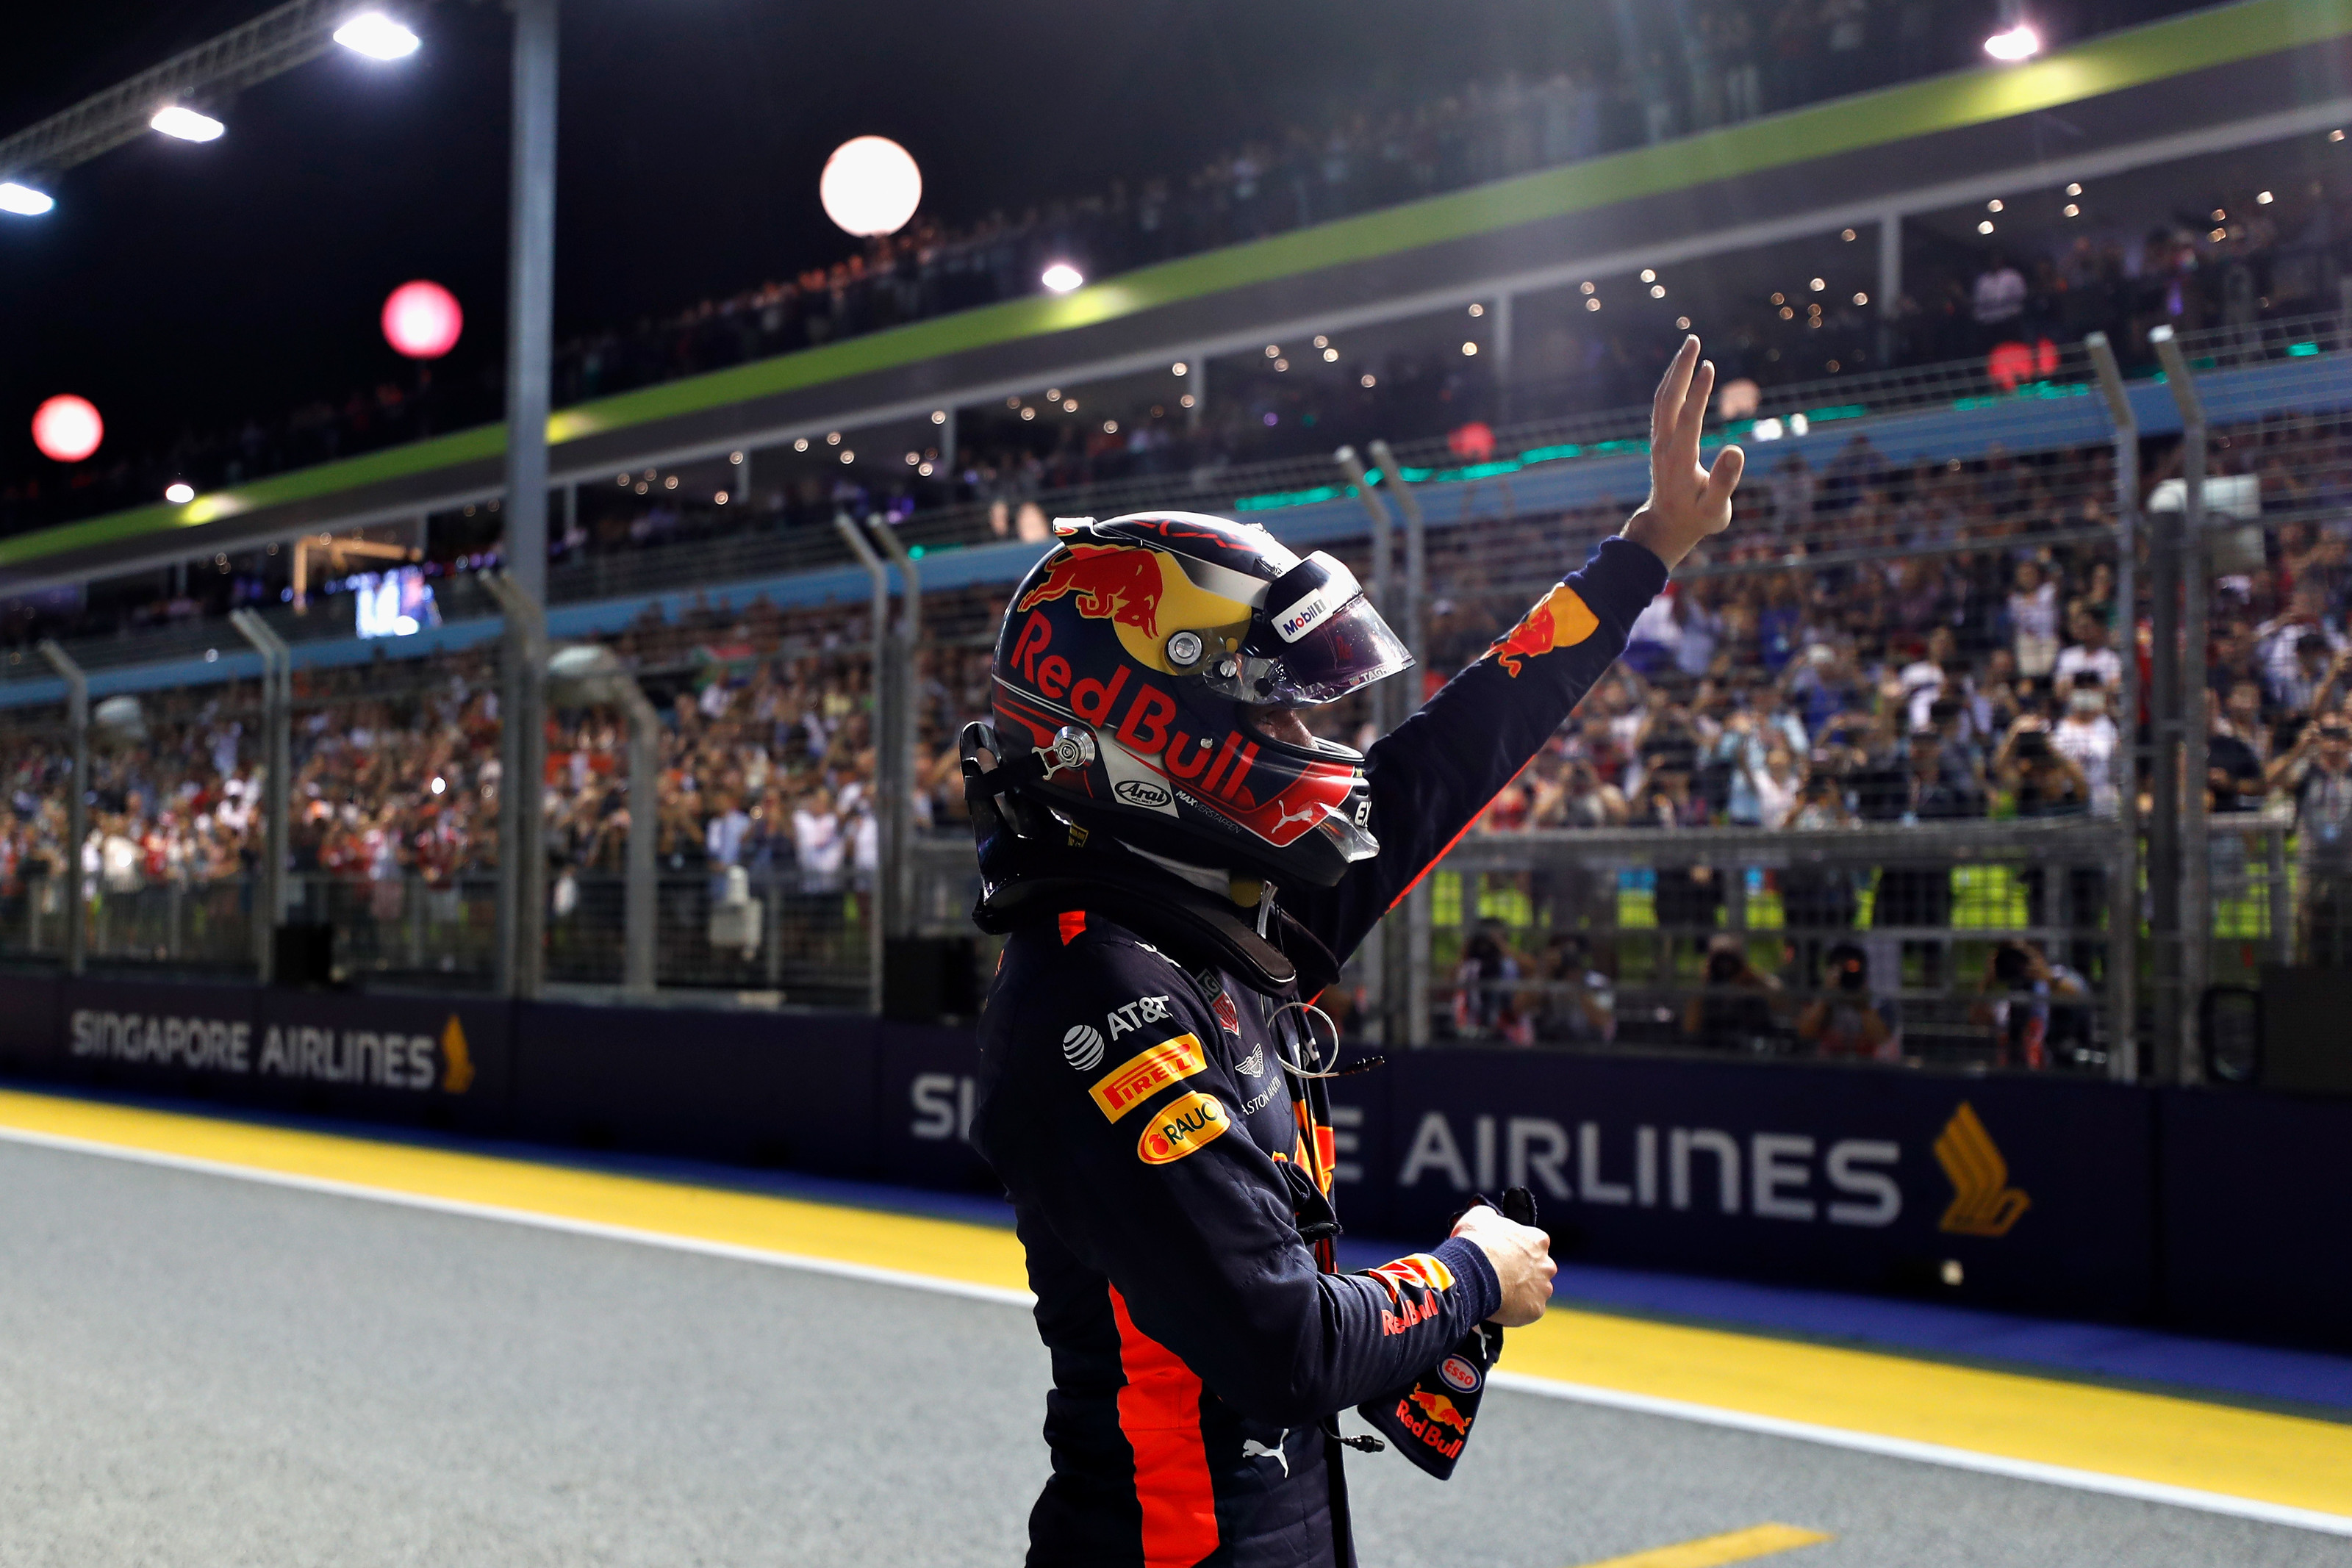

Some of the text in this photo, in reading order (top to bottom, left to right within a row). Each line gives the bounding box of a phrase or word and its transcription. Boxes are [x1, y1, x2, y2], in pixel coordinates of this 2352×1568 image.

[1283, 605, 1316, 636] Mobil
[1011, 610, 1261, 802] Red Bull
[1119, 783, 1166, 802] Arai
[1107, 995, 1173, 1041] AT&T
[71, 1009, 435, 1090] SINGAPORE AIRLINES
[1102, 1043, 1197, 1110] PIRELLI
[1163, 1101, 1218, 1146] RAUC
[1399, 1111, 1902, 1228] AIRLINES
[1396, 1398, 1463, 1459] Red Bull
